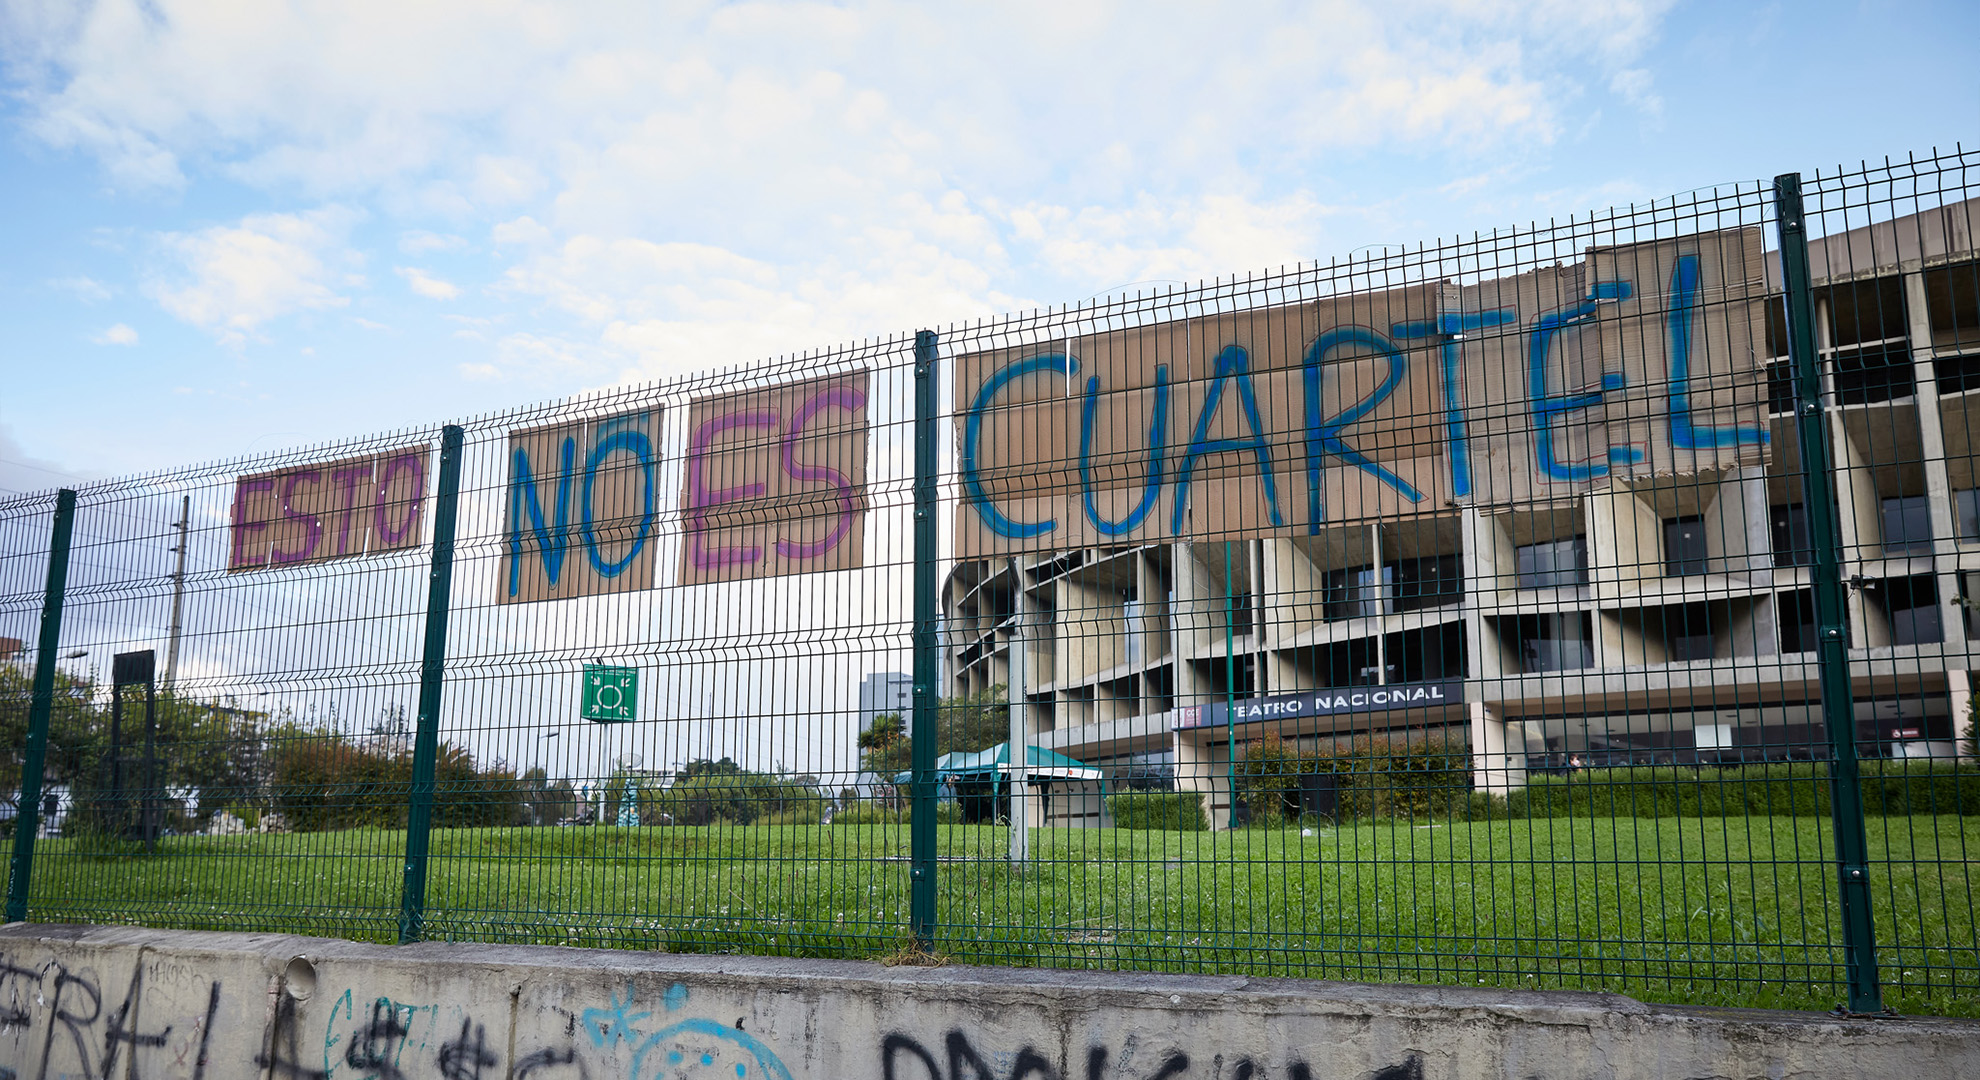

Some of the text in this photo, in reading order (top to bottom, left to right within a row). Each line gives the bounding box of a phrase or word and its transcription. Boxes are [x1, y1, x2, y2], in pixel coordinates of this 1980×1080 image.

[233, 252, 1772, 598] ESTO NO ES CUARTEL
[1315, 686, 1444, 710] NACIONAL
